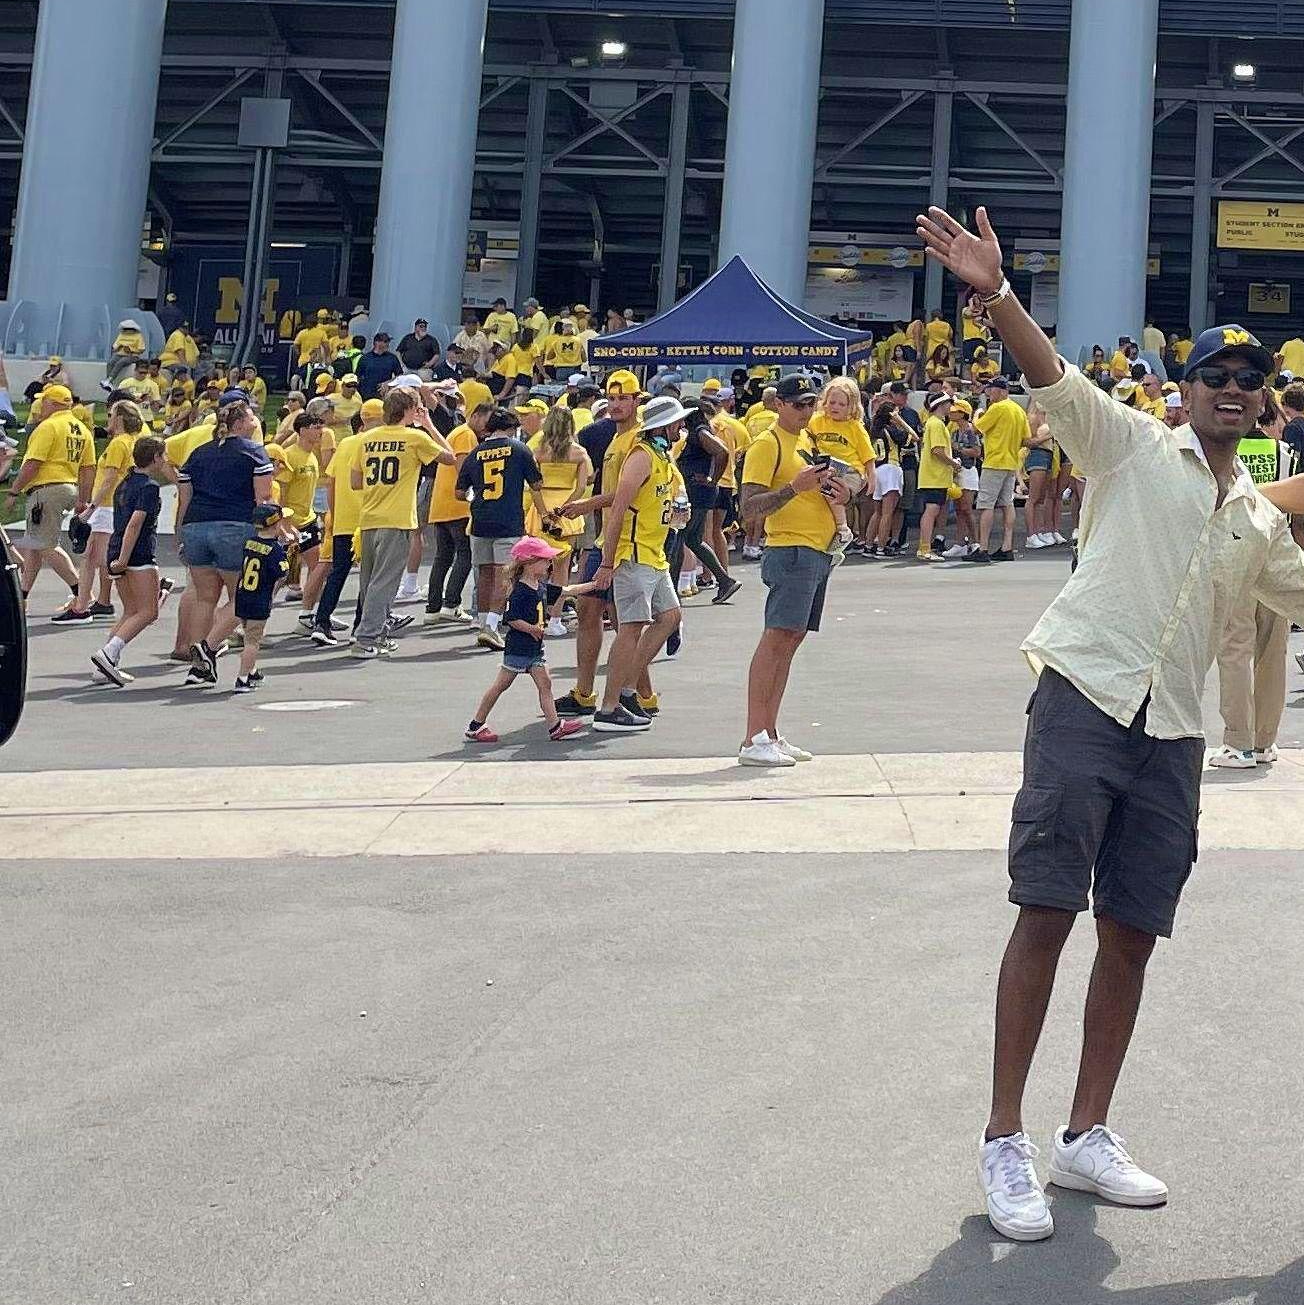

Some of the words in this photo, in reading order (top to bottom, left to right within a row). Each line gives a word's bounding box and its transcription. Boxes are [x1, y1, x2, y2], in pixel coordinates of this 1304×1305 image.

[1267, 208, 1280, 217] M
[1255, 290, 1282, 302] 34
[1222, 328, 1250, 346] M
[593, 346, 659, 357] SNO-CONES
[666, 346, 711, 356] KETTLE
[712, 346, 744, 356] CORN
[752, 346, 801, 356] COTTON
[802, 346, 840, 356] CANDY
[364, 440, 406, 453] WIEBE
[366, 455, 400, 486] 30
[1248, 463, 1276, 474] UEST
[482, 458, 506, 501] 5
